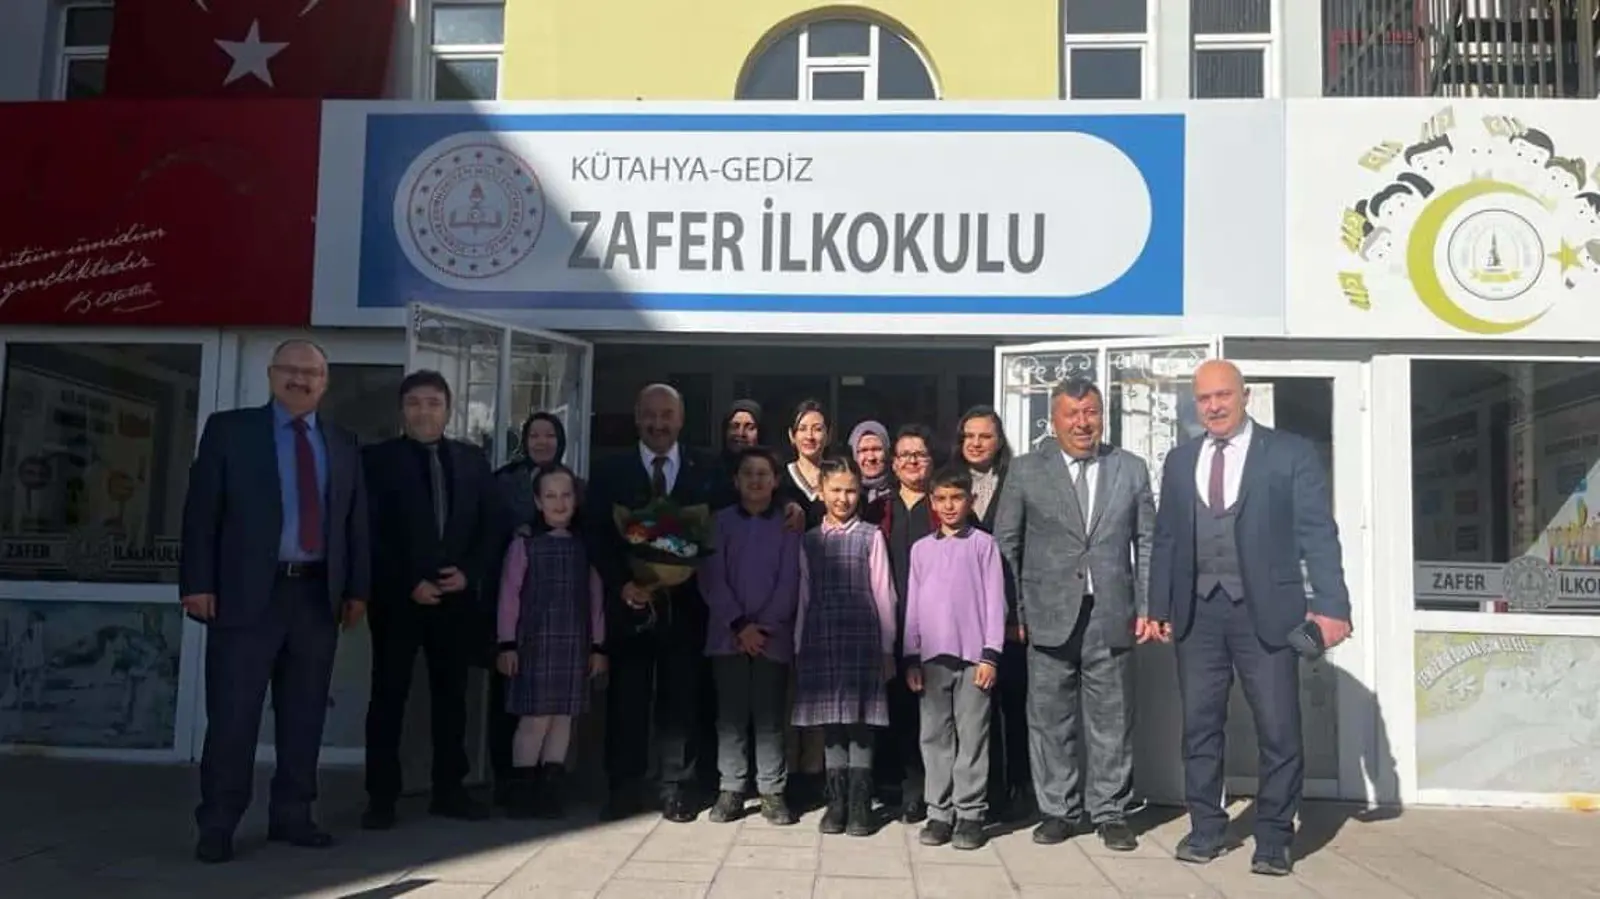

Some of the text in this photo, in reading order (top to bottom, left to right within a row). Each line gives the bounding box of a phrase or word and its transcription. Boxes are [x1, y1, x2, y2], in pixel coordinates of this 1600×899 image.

[571, 151, 813, 182] KÜTAHYA-GEDİZ
[567, 210, 744, 272] ZAFER
[761, 196, 1045, 273] İLKOKULU
[0, 242, 62, 269] ütün
[7, 543, 50, 558] ZAFER
[1432, 572, 1486, 591] ZAFER
